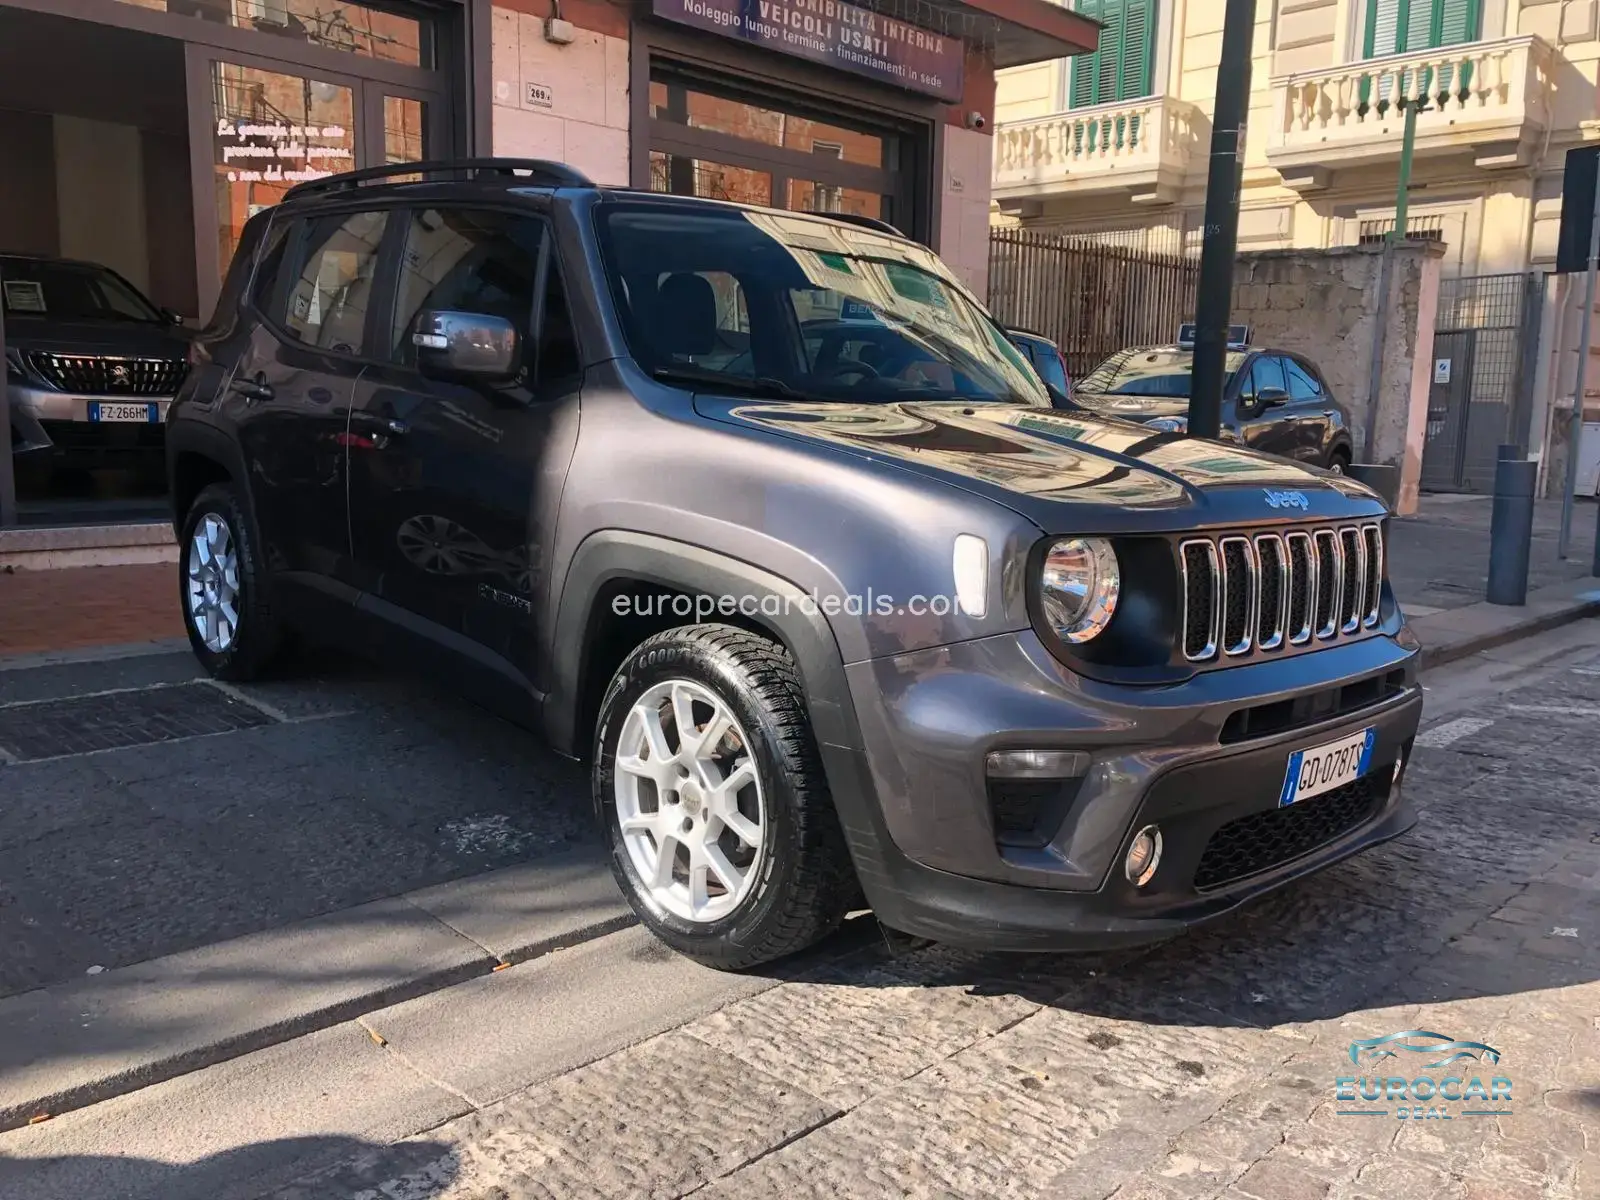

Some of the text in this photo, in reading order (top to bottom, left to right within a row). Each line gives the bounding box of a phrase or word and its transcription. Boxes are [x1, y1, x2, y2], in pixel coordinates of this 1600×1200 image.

[684, 0, 942, 88] Noleggio lungo termine finanziamenti in sede
[759, 1, 888, 57] VEICOLI USATI
[883, 20, 944, 55] INTERNA
[1262, 488, 1309, 511] Jeep
